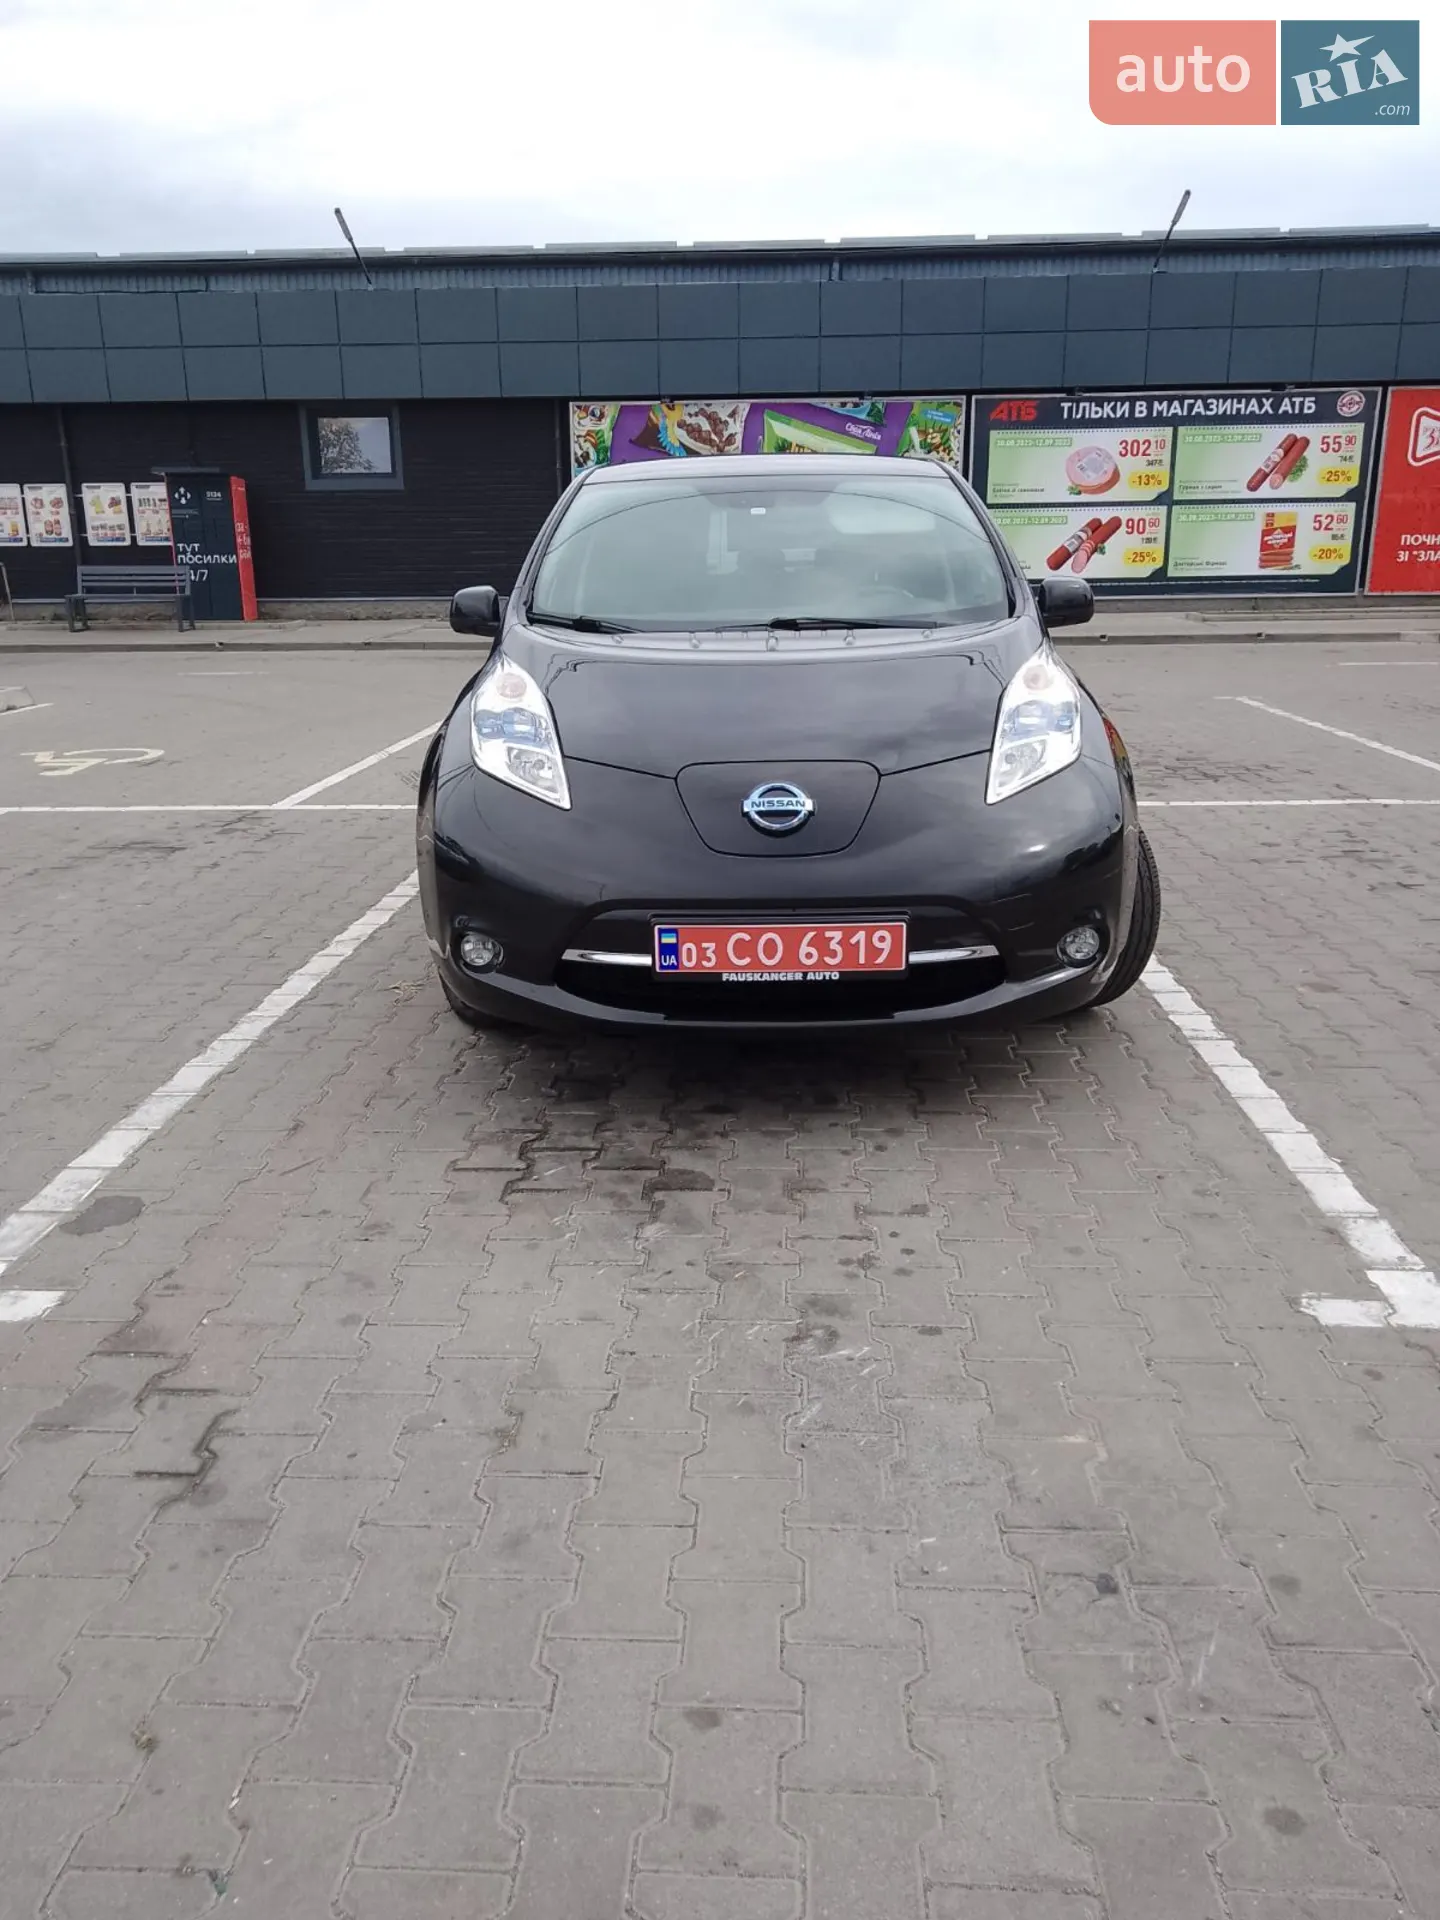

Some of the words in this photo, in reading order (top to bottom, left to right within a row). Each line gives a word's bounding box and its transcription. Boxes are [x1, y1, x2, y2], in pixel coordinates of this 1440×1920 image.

[989, 401, 1039, 421] АТБ
[1060, 400, 1130, 420] ТІЛЬКИ
[1134, 400, 1148, 419] В
[1152, 397, 1274, 418] МАГАЗИНАХ
[1278, 396, 1317, 415] АТБ
[1119, 439, 1152, 457] 302
[1154, 438, 1167, 450] 10
[1320, 435, 1343, 453] 55
[1344, 434, 1357, 446] 90
[1132, 474, 1162, 486] -13%
[1321, 470, 1352, 482] -25%
[1125, 517, 1147, 535] 90
[1148, 517, 1160, 528] 60
[1313, 514, 1334, 531] 52
[1336, 514, 1349, 525] 60
[1401, 534, 1440, 546] ПОЧН
[1127, 551, 1157, 563] -25%
[1313, 548, 1344, 560] -20%
[1396, 550, 1409, 562] ЗІ
[750, 799, 806, 809] NISSAN
[661, 954, 677, 966] UA
[681, 942, 717, 968] 03
[726, 931, 784, 966] CO
[798, 929, 893, 967] 6319
[722, 972, 803, 982] FAUSKANGER
[806, 971, 840, 981] AUTO
